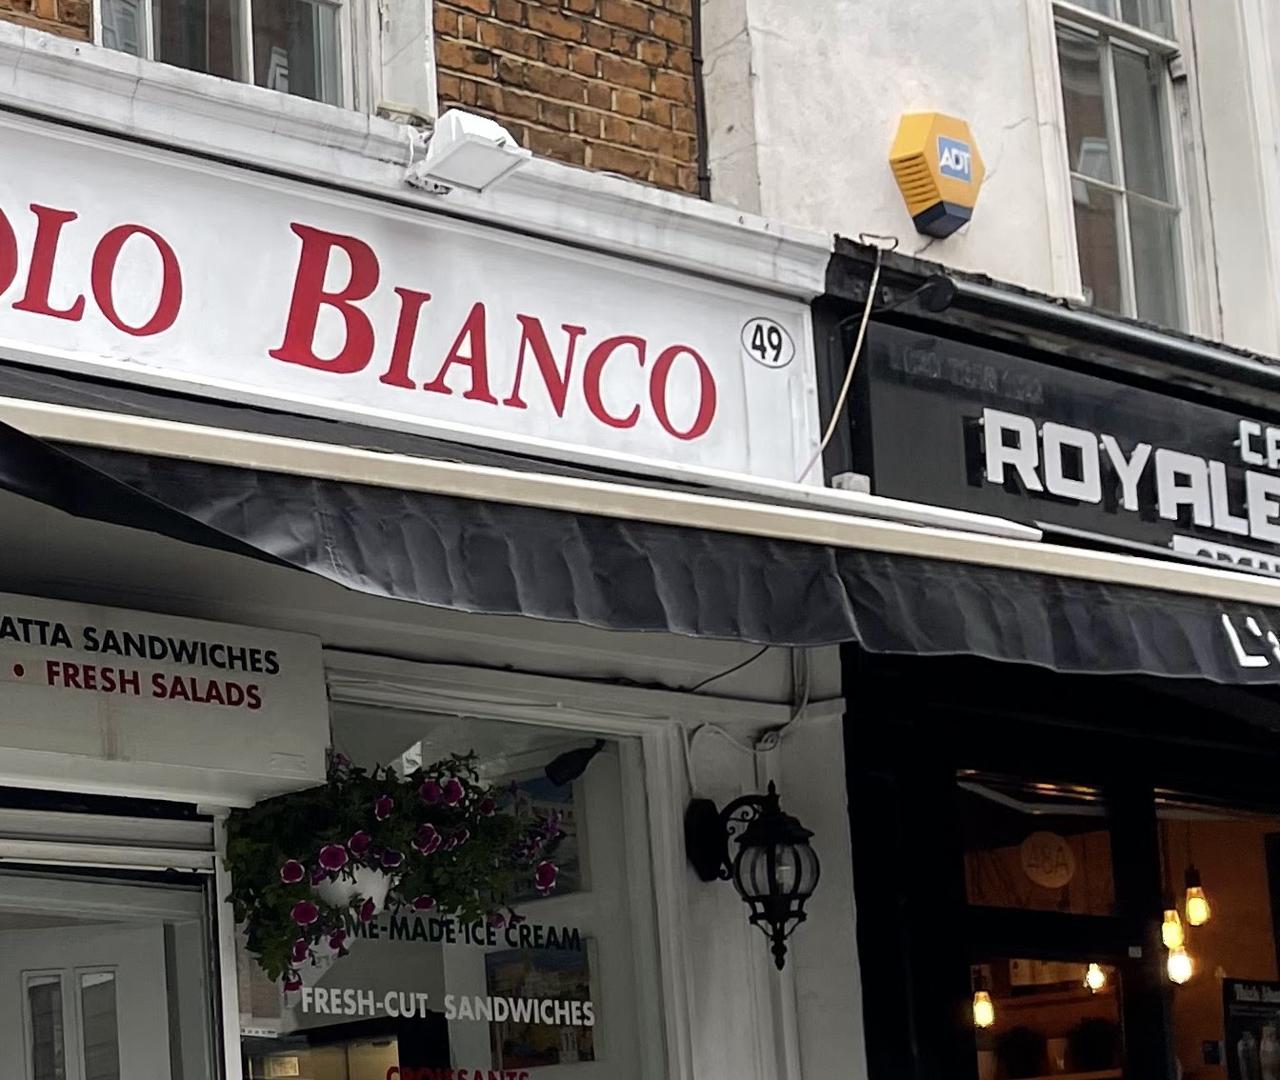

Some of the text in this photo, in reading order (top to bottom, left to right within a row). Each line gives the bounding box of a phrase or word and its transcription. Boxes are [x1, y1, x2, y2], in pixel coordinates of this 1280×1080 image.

[939, 145, 971, 174] ADT
[269, 222, 718, 441] BIANCO
[751, 324, 783, 363] 49
[82, 625, 280, 675] SANDWICHES
[46, 660, 141, 697] FRESH
[151, 672, 262, 711] SALADS
[342, 912, 582, 951] ME-MADE ICE CREAM
[301, 987, 596, 1027] FRESH-CUT SANDWICHES
